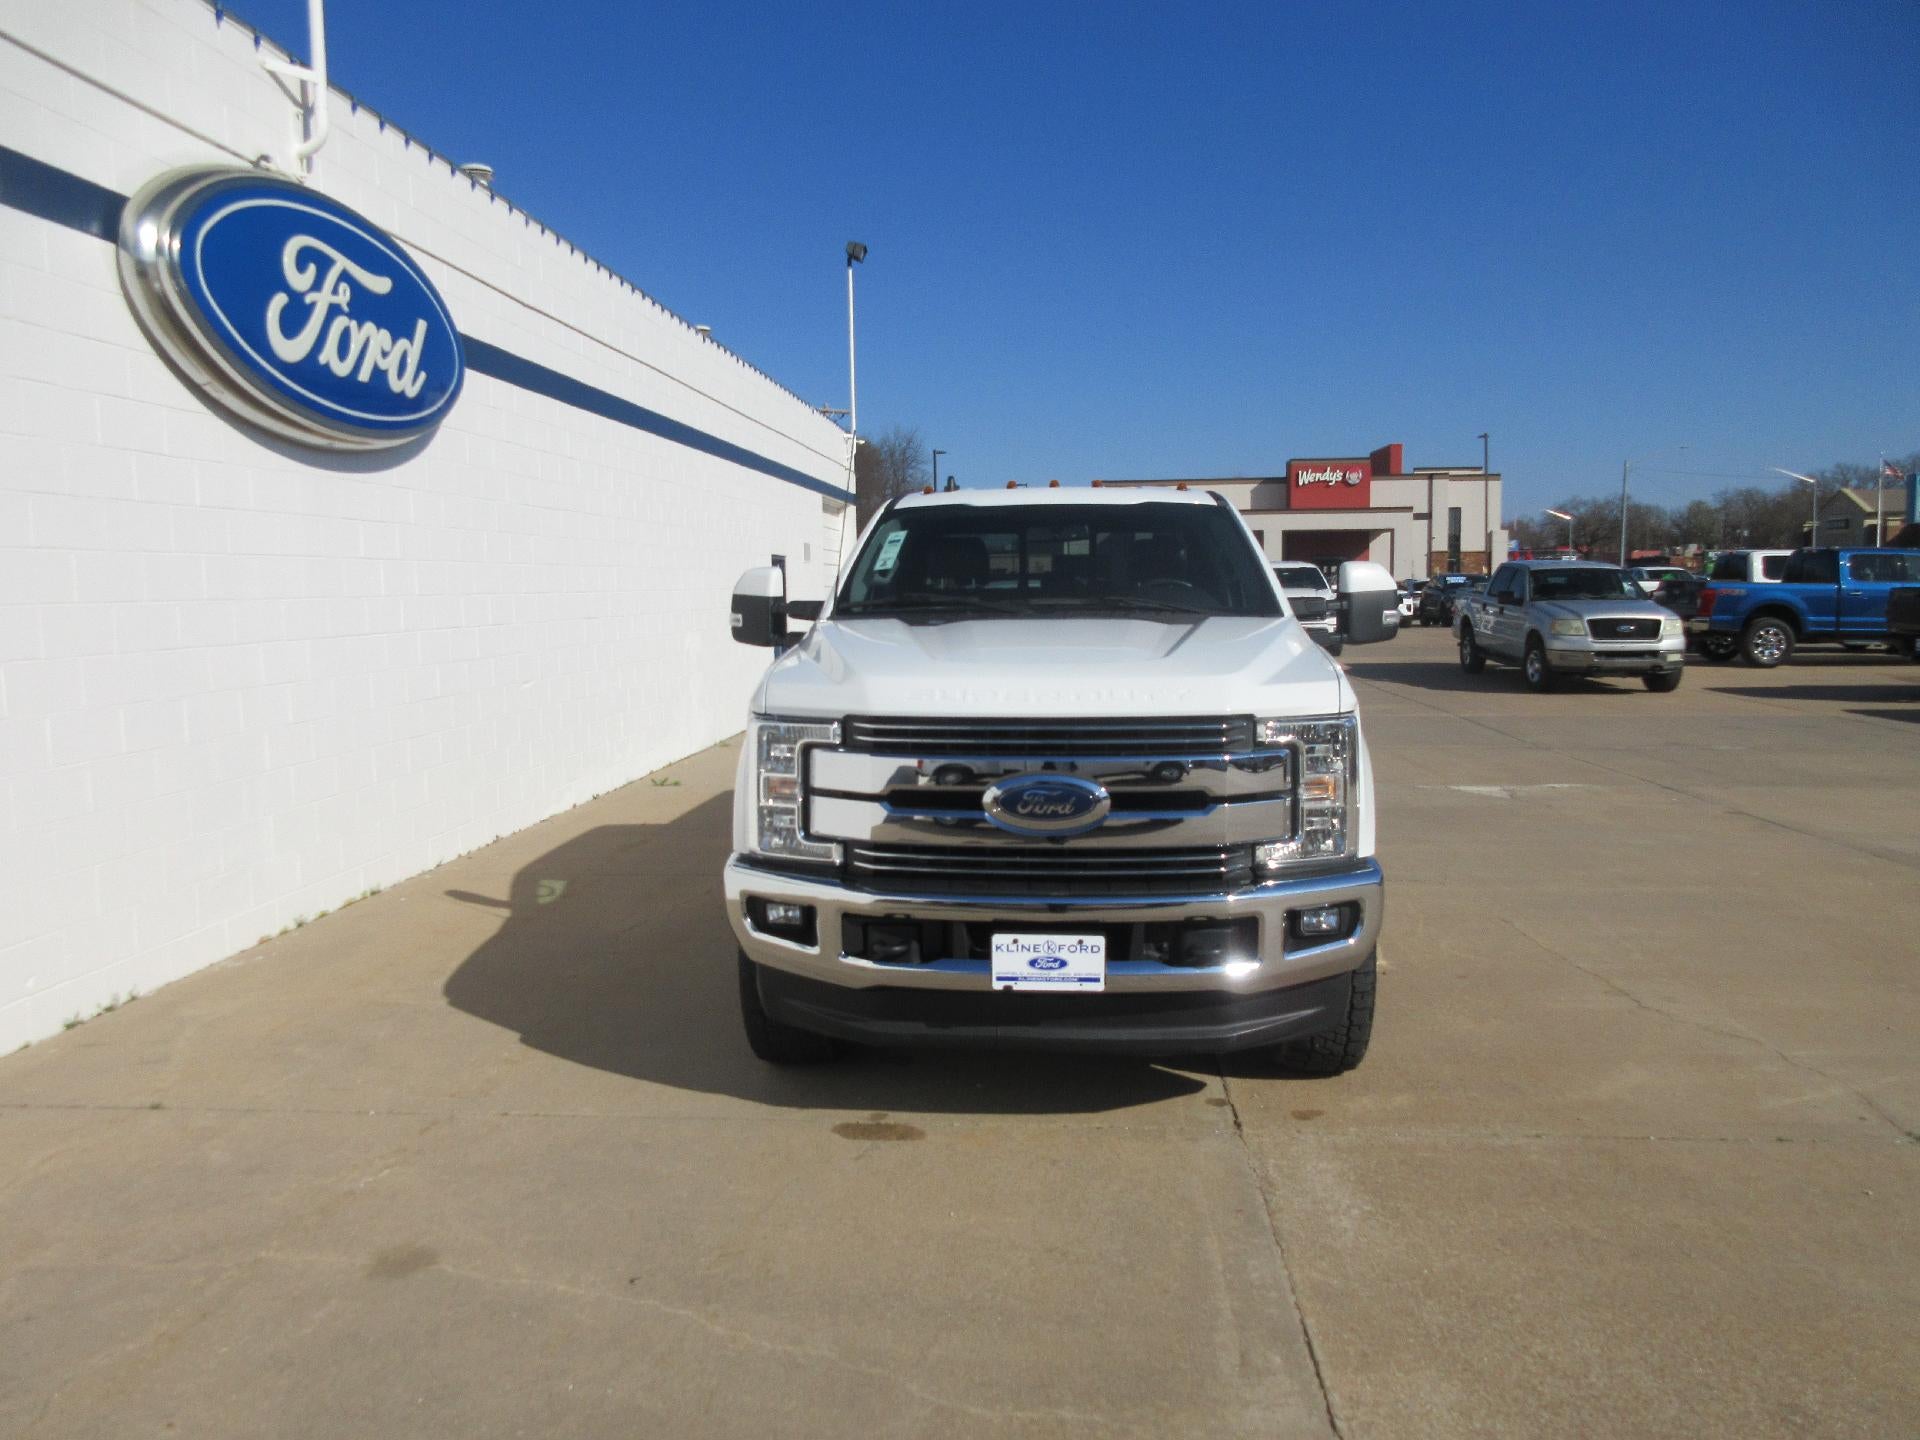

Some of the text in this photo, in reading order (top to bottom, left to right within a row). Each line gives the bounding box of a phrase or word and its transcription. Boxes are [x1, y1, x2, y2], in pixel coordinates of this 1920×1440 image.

[266, 234, 428, 399] Ford
[1298, 466, 1343, 486] Wendy's
[1016, 789, 1075, 816] Ford
[995, 944, 1040, 953] KLINE
[1058, 944, 1101, 954] FORD
[1034, 957, 1061, 969] Ford
